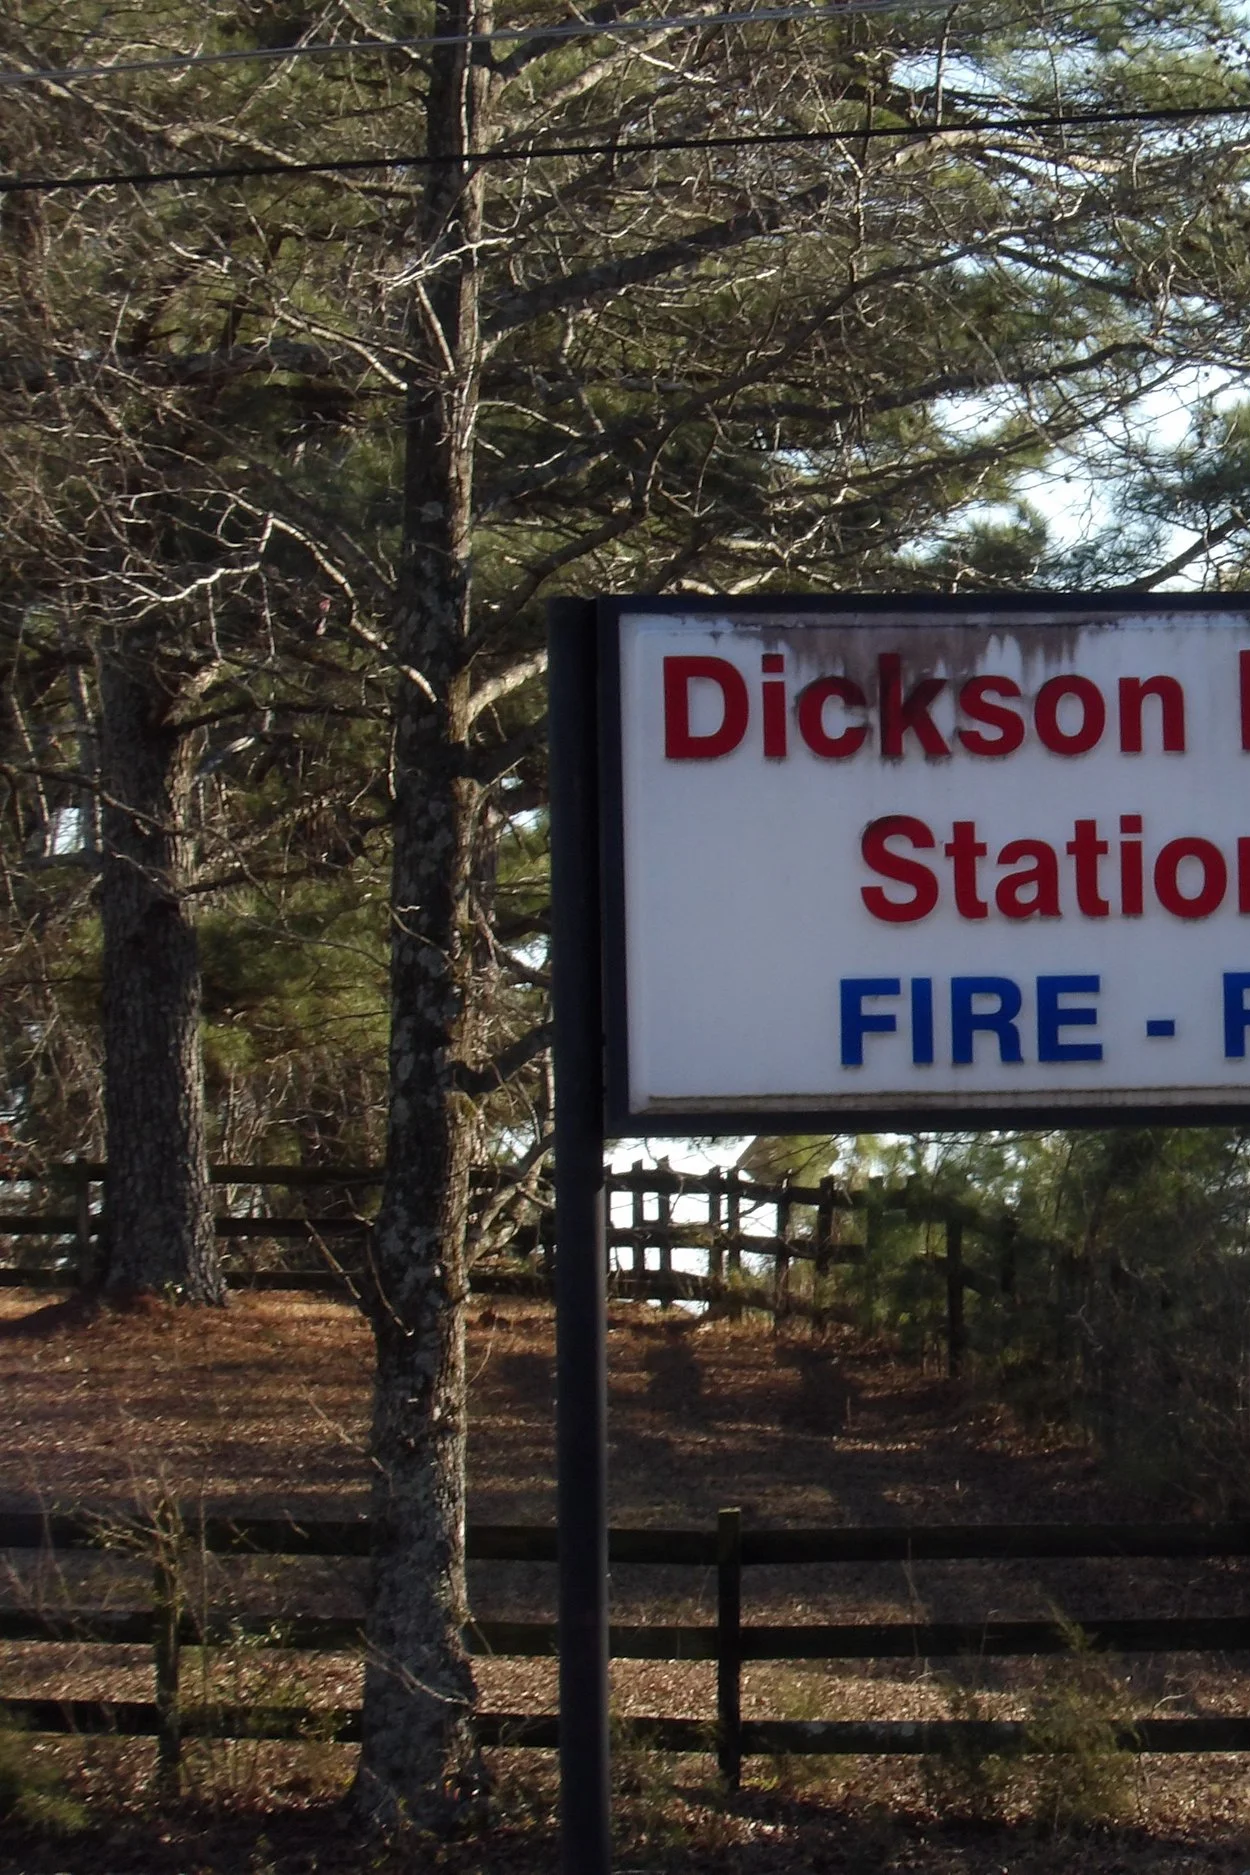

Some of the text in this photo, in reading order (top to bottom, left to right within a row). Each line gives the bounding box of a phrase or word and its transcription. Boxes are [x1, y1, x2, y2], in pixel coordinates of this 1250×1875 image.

[663, 653, 1187, 761] Dickson
[840, 974, 1103, 1066] FIRE
[1146, 1019, 1176, 1037] -
